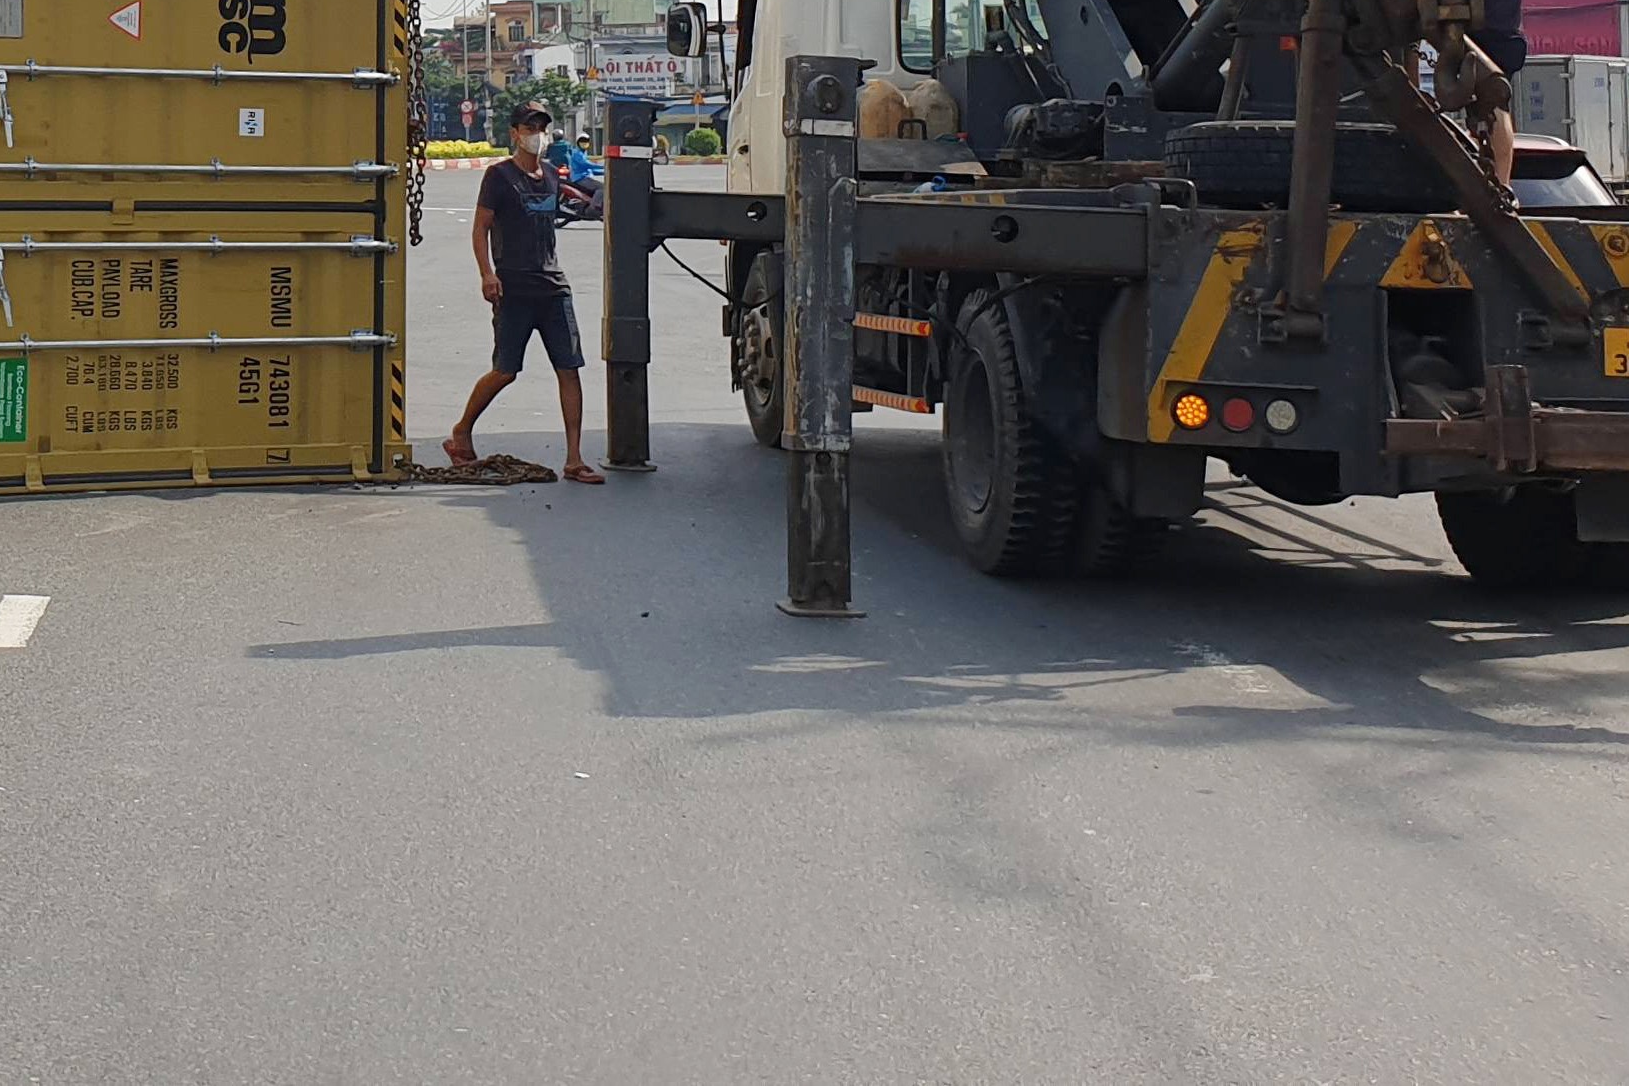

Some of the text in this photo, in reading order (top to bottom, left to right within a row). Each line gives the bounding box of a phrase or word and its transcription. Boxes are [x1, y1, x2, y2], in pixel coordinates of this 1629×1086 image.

[601, 58, 620, 76] ỘI
[625, 55, 664, 74] THẤT
[101, 258, 121, 319] PAYLOAD
[129, 259, 153, 292] TARE
[159, 258, 178, 330] MAXGROSS
[270, 266, 292, 328] MSMU
[238, 356, 260, 406] 45G1
[15, 365, 25, 435] Eco-Container
[268, 355, 290, 463] 743081 7
[65, 405, 78, 433] CUFT
[82, 411, 94, 434] CUM
[108, 410, 120, 432] KGS
[124, 410, 137, 432] LBS
[140, 410, 152, 432] KGS
[166, 408, 178, 430] KGS
